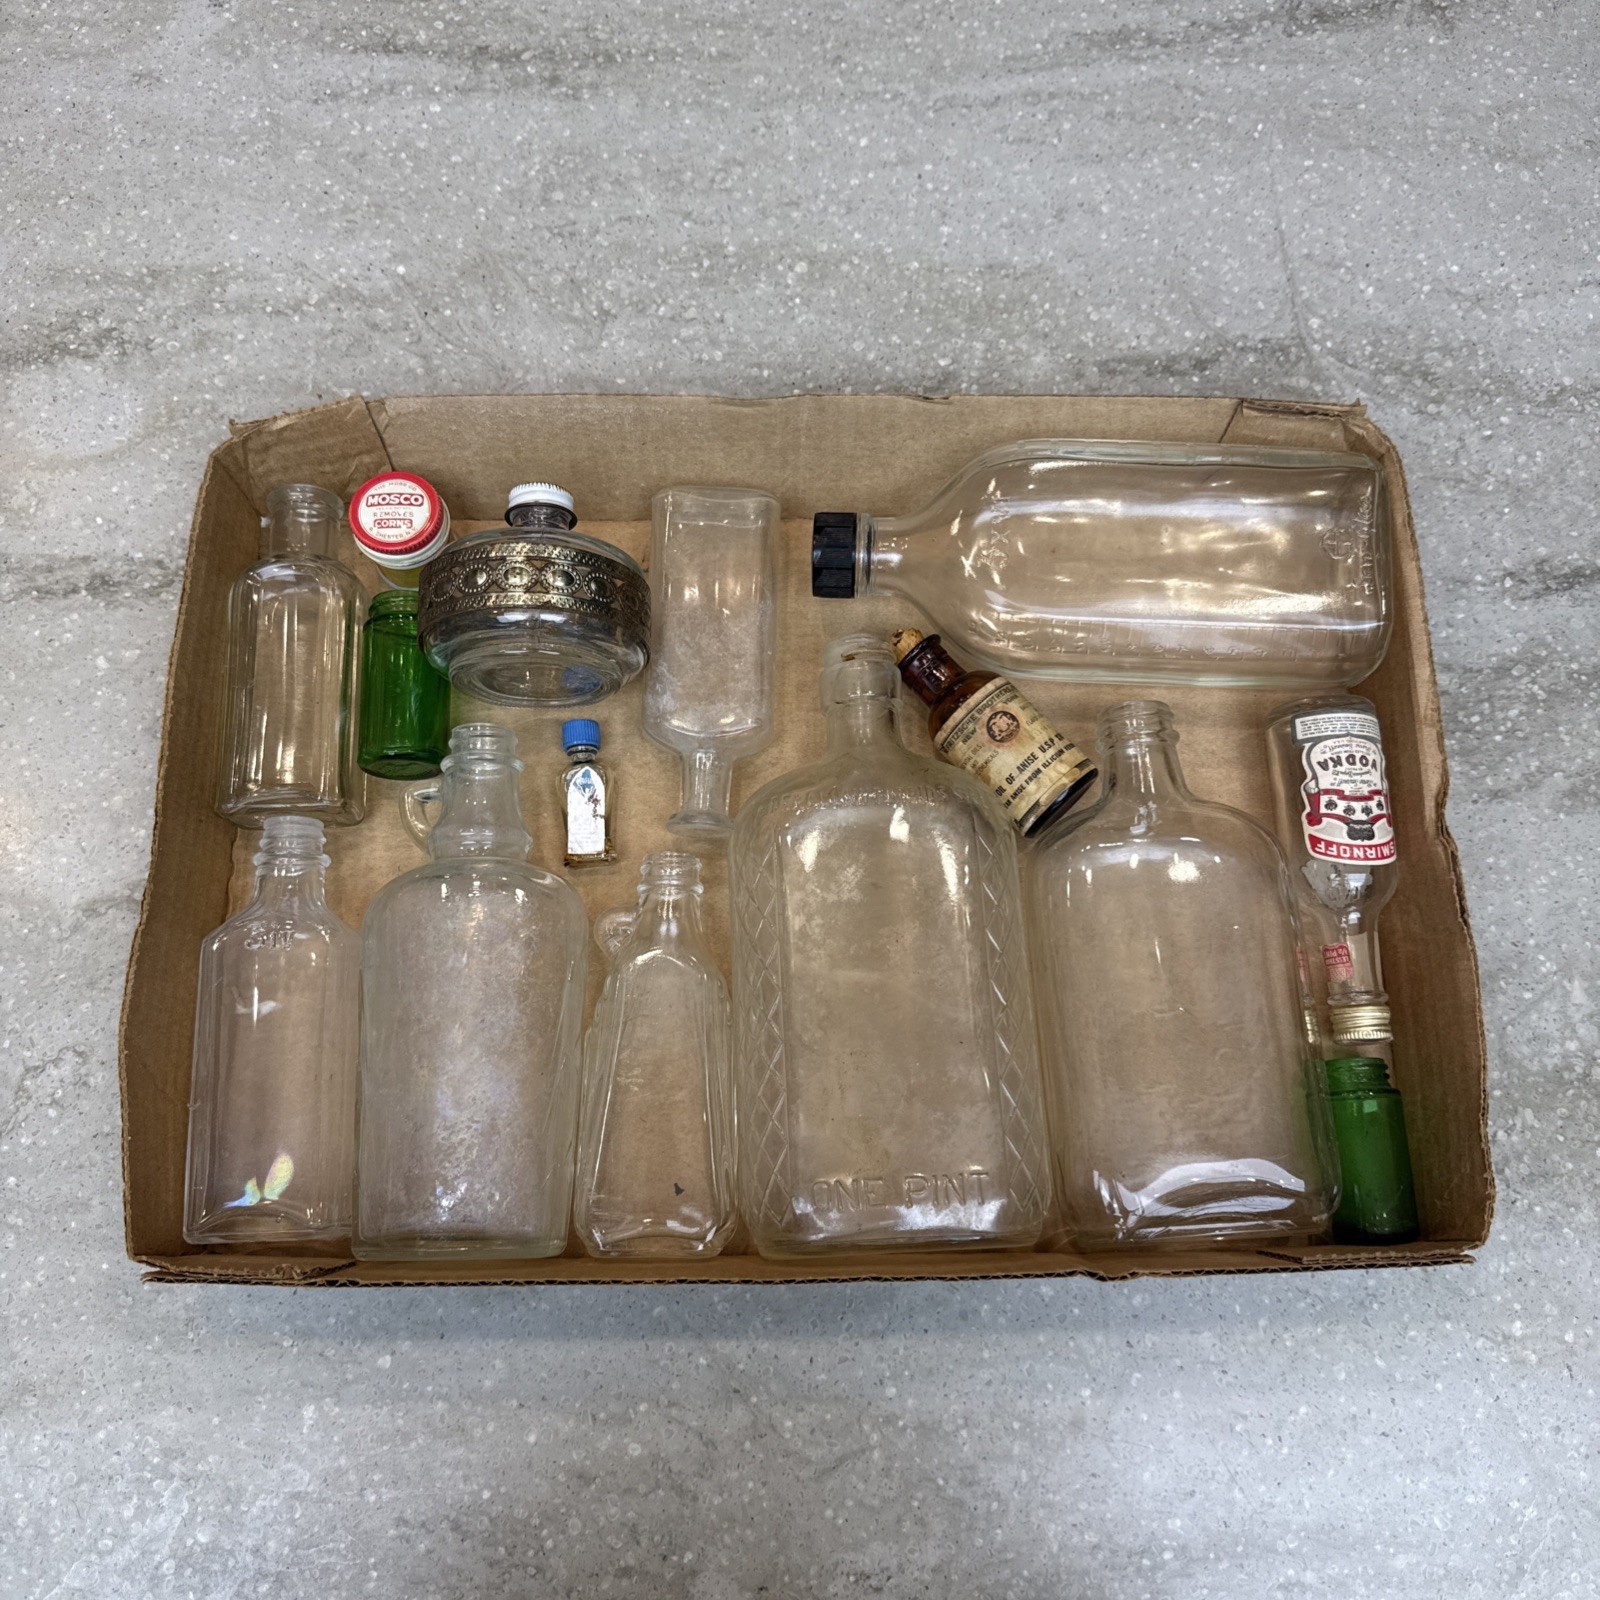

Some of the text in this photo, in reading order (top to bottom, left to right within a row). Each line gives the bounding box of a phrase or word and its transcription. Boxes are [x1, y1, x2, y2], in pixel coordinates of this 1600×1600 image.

[367, 494, 423, 506] MOSCO
[374, 519, 411, 528] CORNS
[961, 727, 977, 746] NEW
[1316, 754, 1378, 772] VODKA
[994, 784, 1007, 797] OIL
[1005, 773, 1016, 786] OF
[1015, 751, 1040, 776] ANISE
[1010, 784, 1026, 801] ANISE
[1024, 767, 1042, 786] FROM
[1314, 841, 1395, 859] SMIRNOFF
[809, 1168, 990, 1213] ONE PINT
